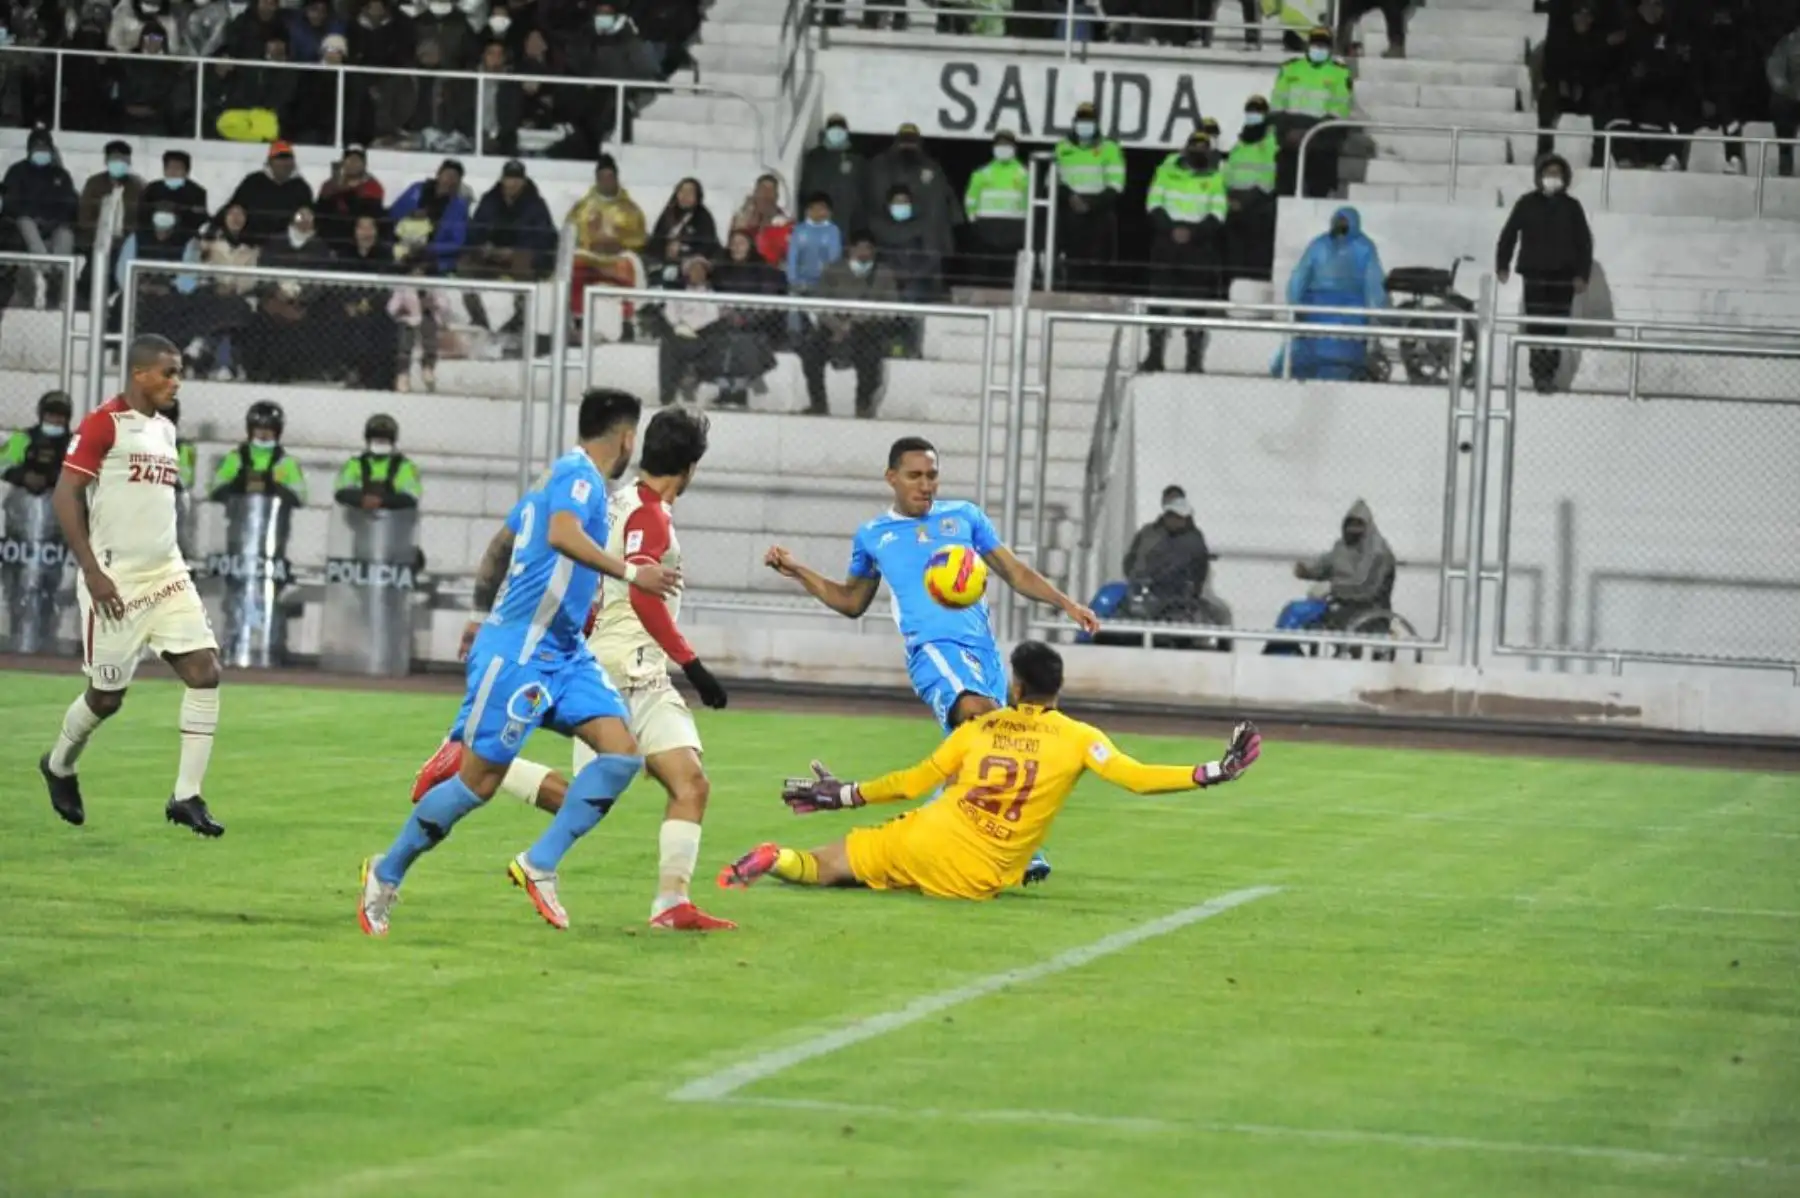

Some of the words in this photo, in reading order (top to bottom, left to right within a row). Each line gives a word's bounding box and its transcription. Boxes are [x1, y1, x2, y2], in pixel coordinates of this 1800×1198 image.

[938, 62, 1204, 143] SALIDA
[0, 540, 80, 569] OLICIA
[327, 559, 414, 589] POLICIA
[964, 754, 1039, 823] 21
